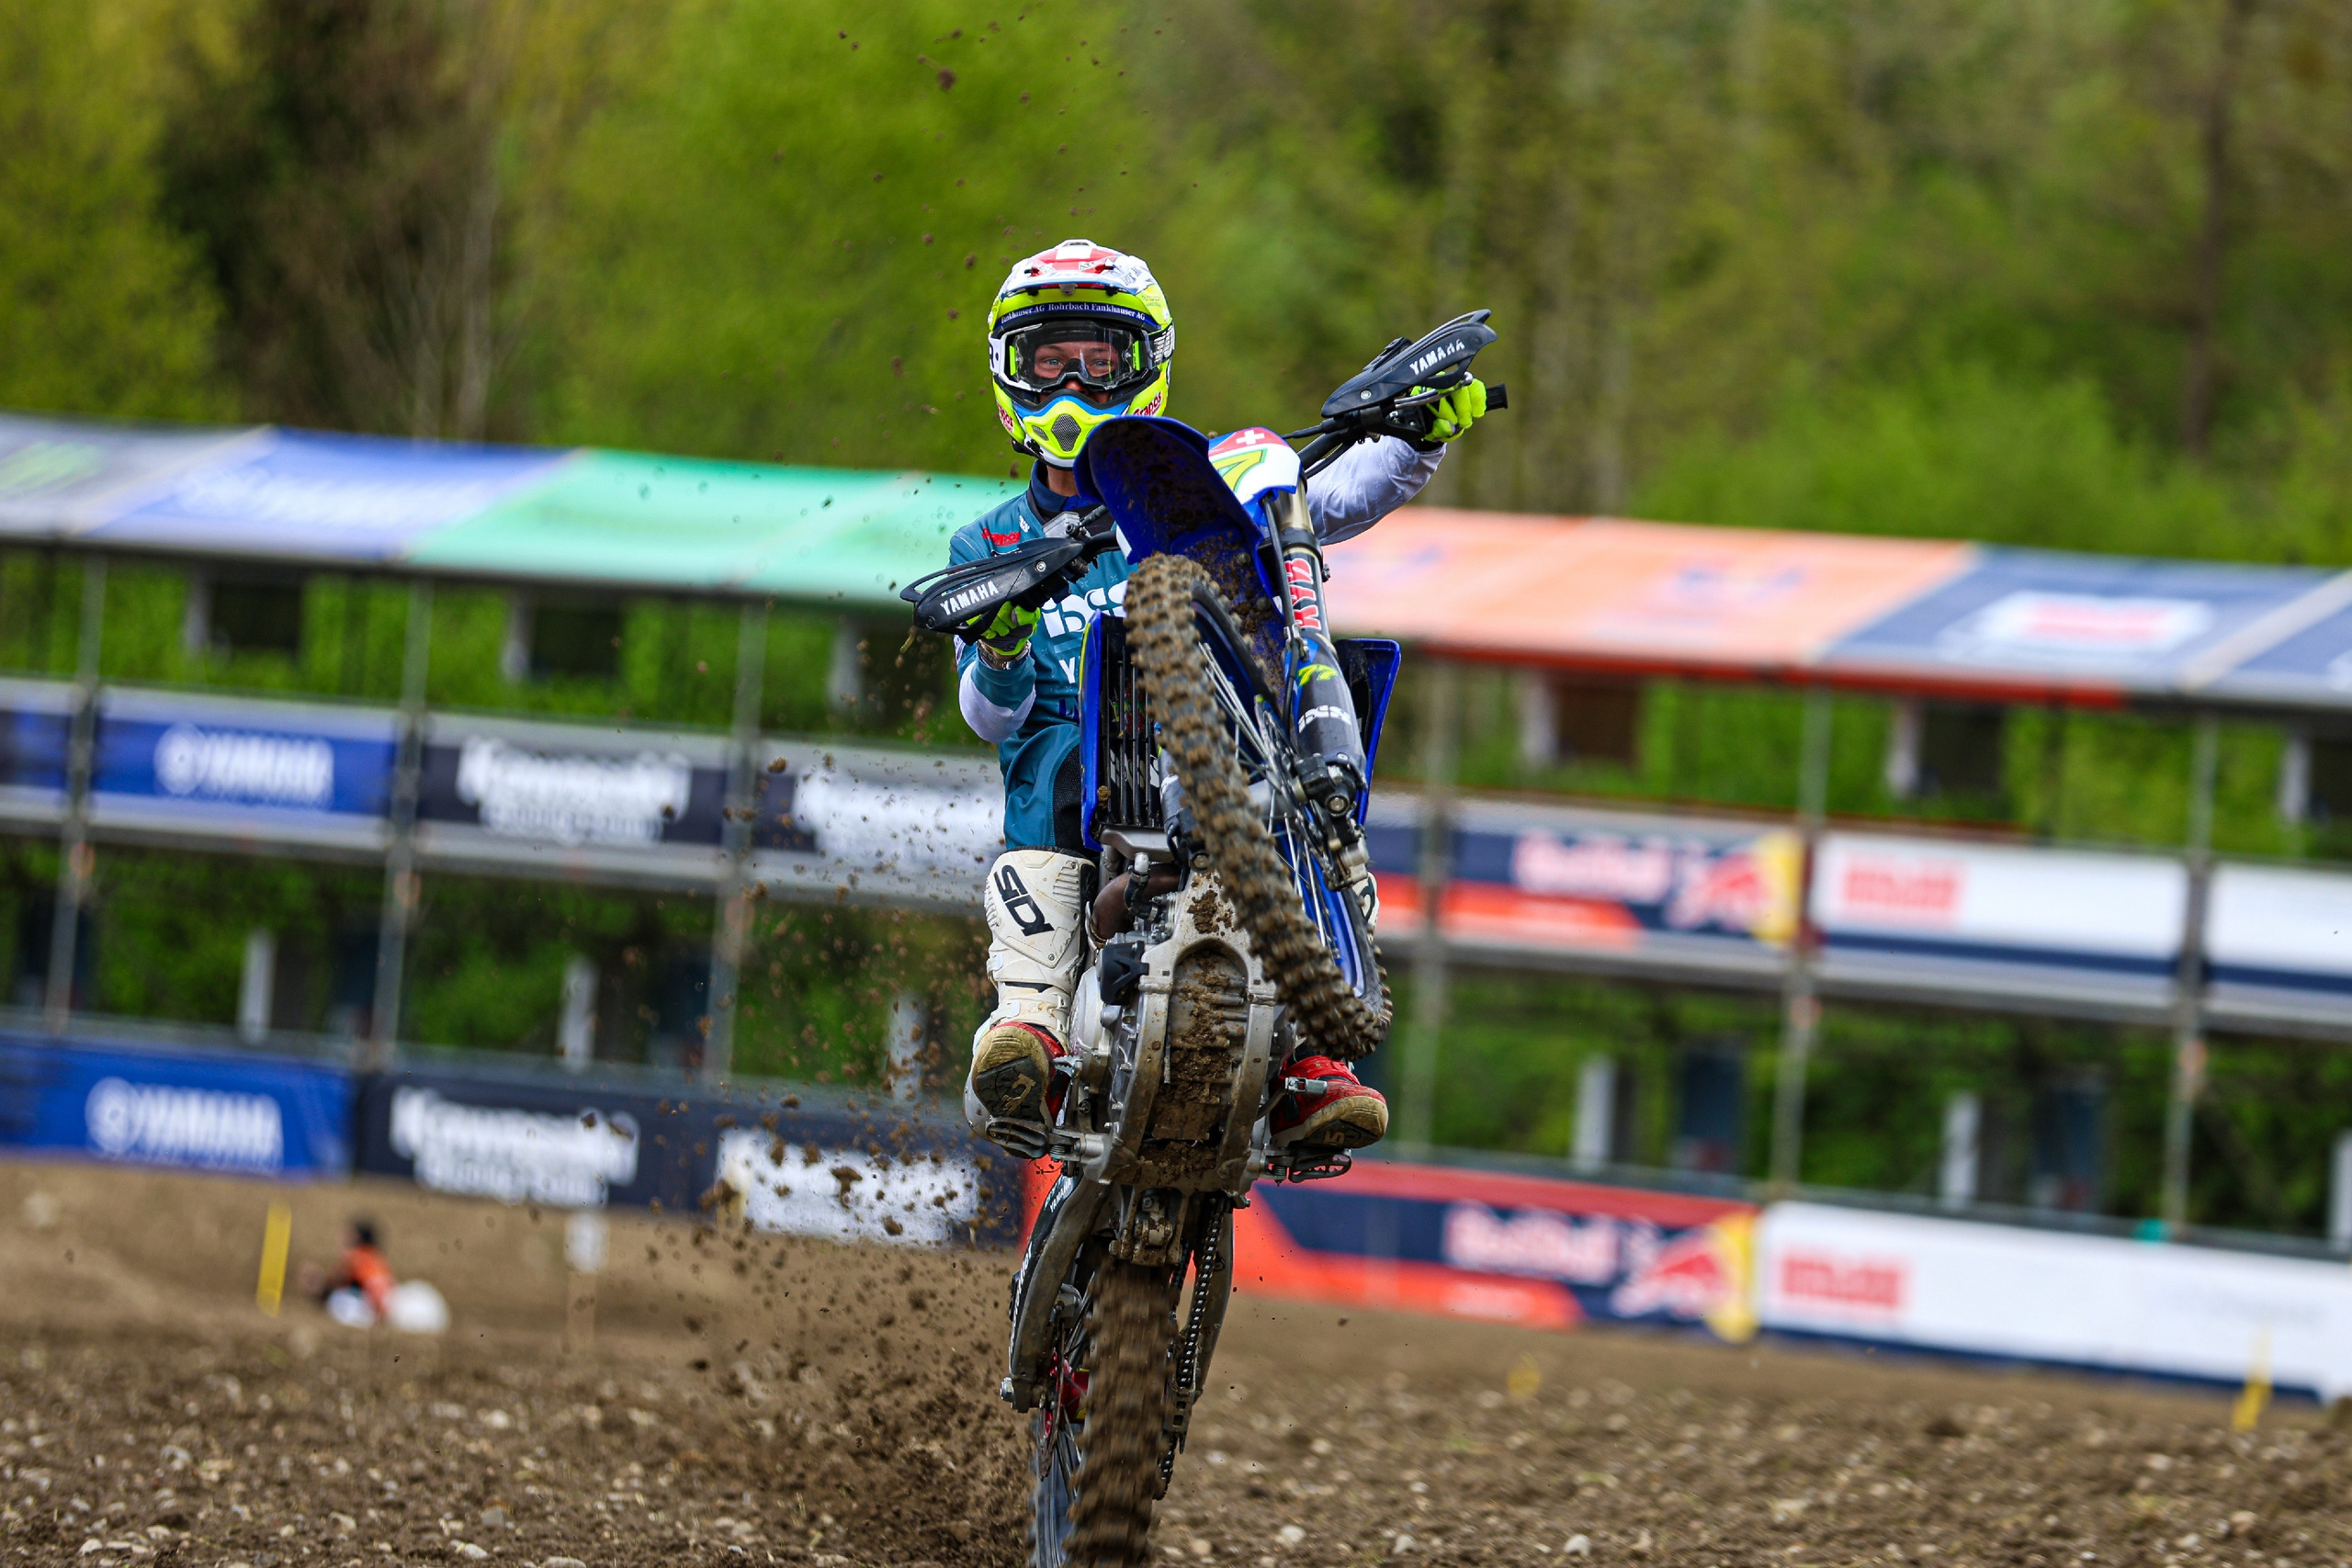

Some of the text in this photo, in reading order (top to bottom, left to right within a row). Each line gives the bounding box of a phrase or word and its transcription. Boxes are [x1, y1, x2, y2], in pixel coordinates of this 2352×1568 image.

[1034, 305, 1045, 313] AG
[1048, 302, 1090, 310] Rohrbach
[1091, 303, 1135, 317] Fankhauser
[1136, 311, 1146, 321] AG
[1409, 338, 1465, 376] YAMAHA
[940, 581, 999, 615] YAMAHA
[1283, 558, 1322, 631] KYB
[1297, 663, 1339, 687] 77
